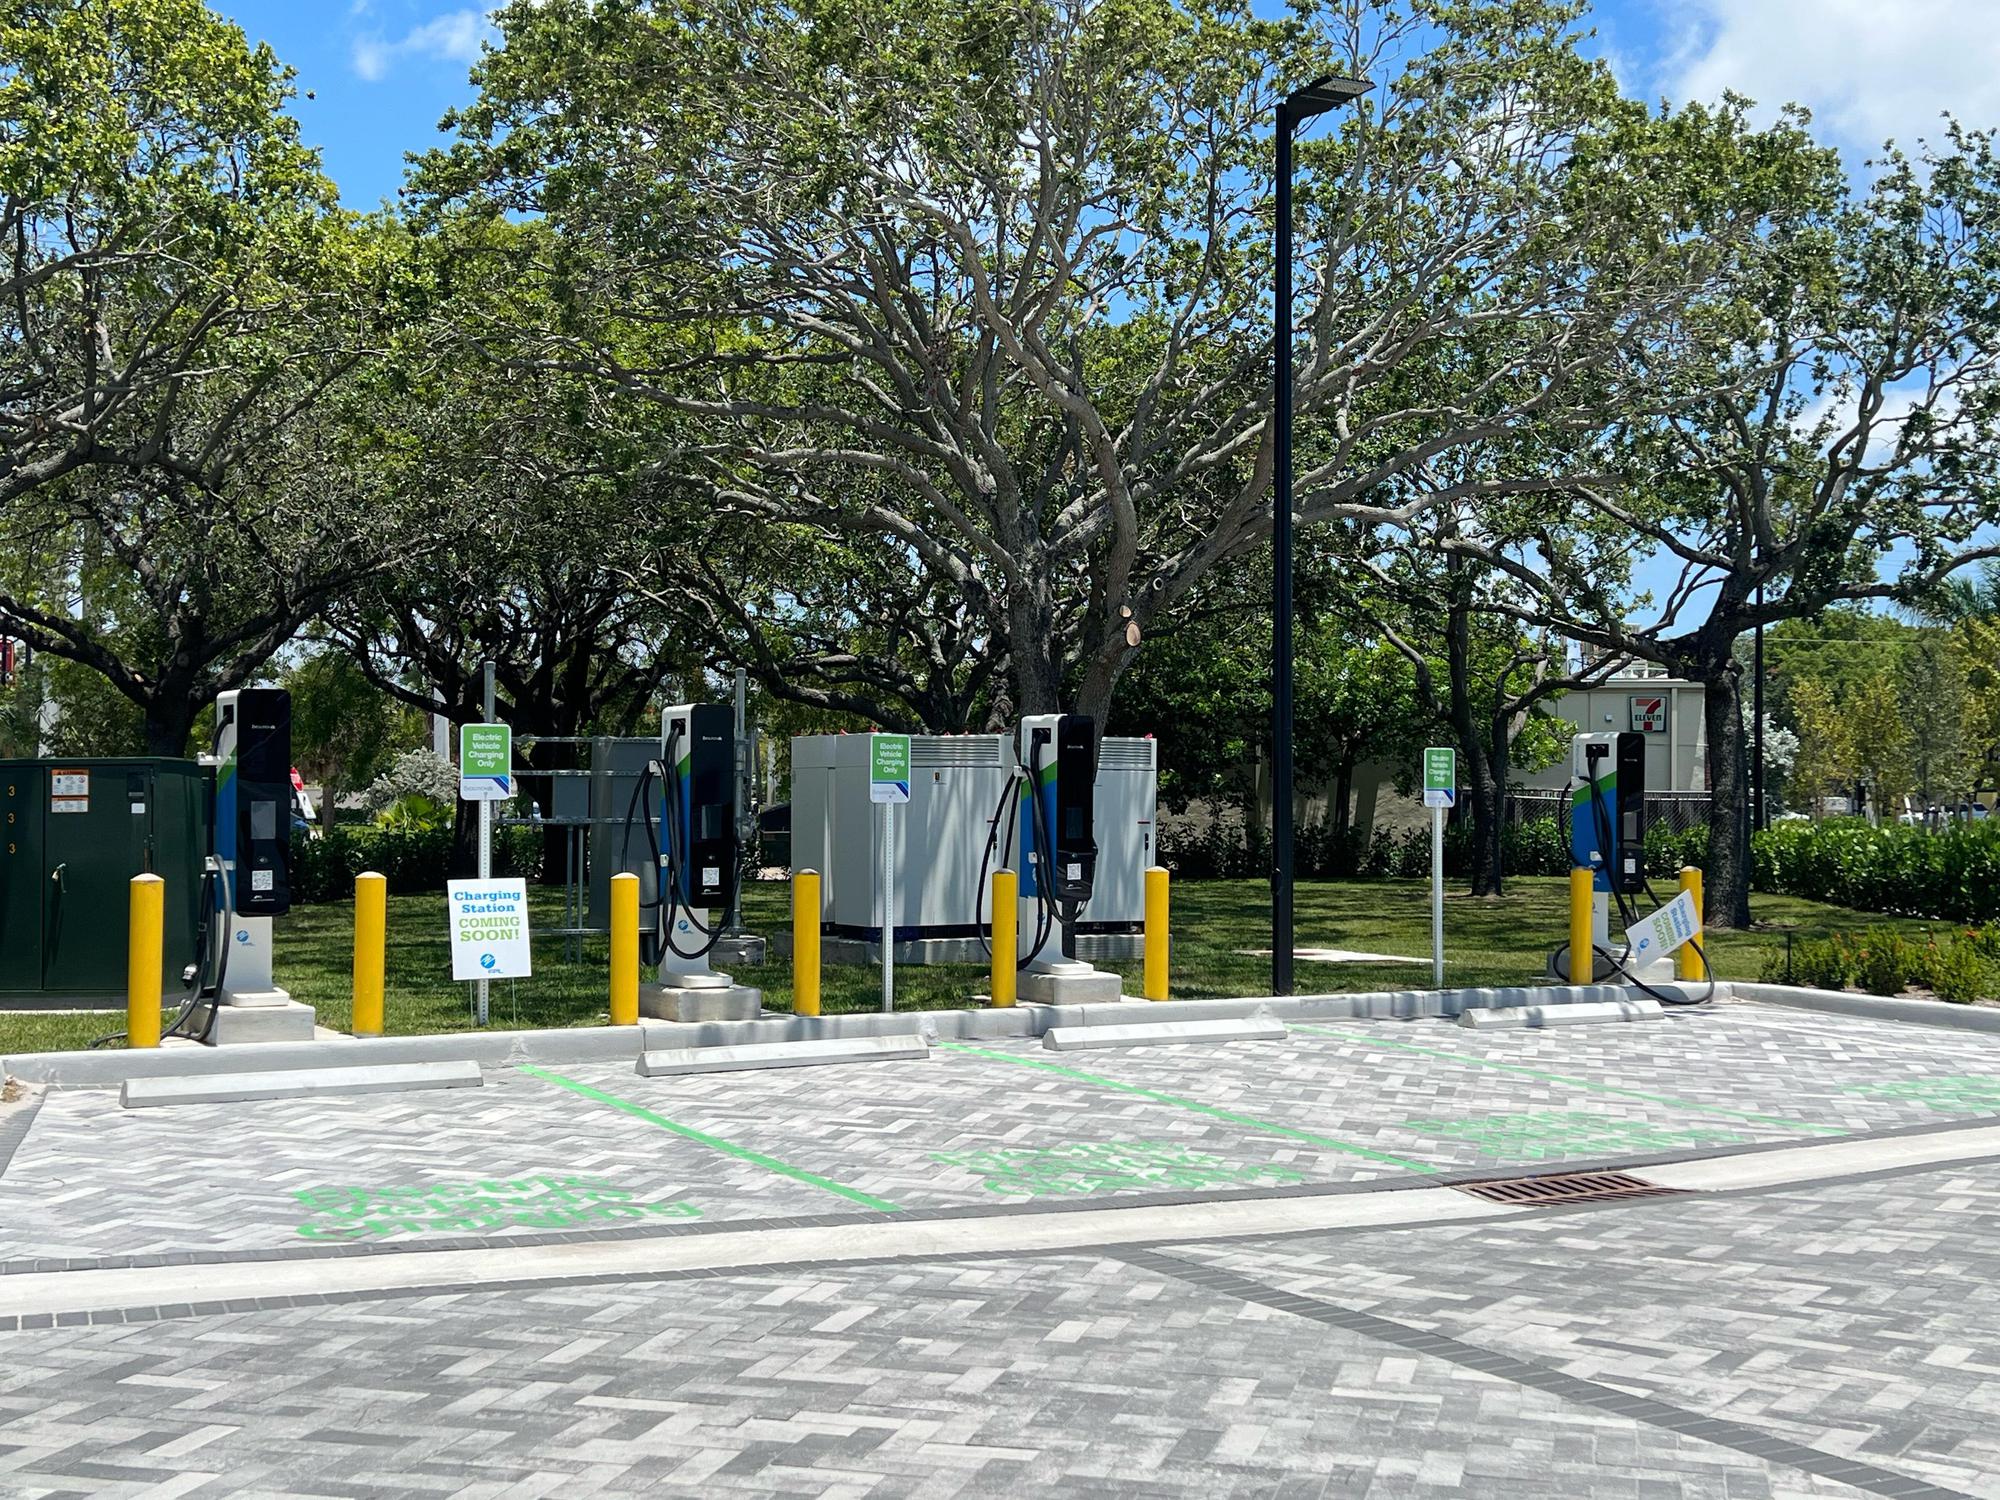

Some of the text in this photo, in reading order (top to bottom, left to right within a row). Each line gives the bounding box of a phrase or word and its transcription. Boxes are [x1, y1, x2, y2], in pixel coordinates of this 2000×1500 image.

[1636, 698, 1661, 730] 7
[472, 733, 502, 741] Electric
[472, 742, 501, 750] Vehicle
[468, 751, 504, 760] Charging
[477, 760, 496, 769] Only
[876, 758, 905, 767] Charging
[883, 766, 898, 775] Only
[8, 785, 15, 797] 3
[7, 812, 15, 824] 3
[8, 843, 16, 854] 3
[454, 891, 521, 901] Charging
[462, 903, 516, 913] Station
[459, 916, 520, 928] COMING
[460, 929, 519, 942] SOON!
